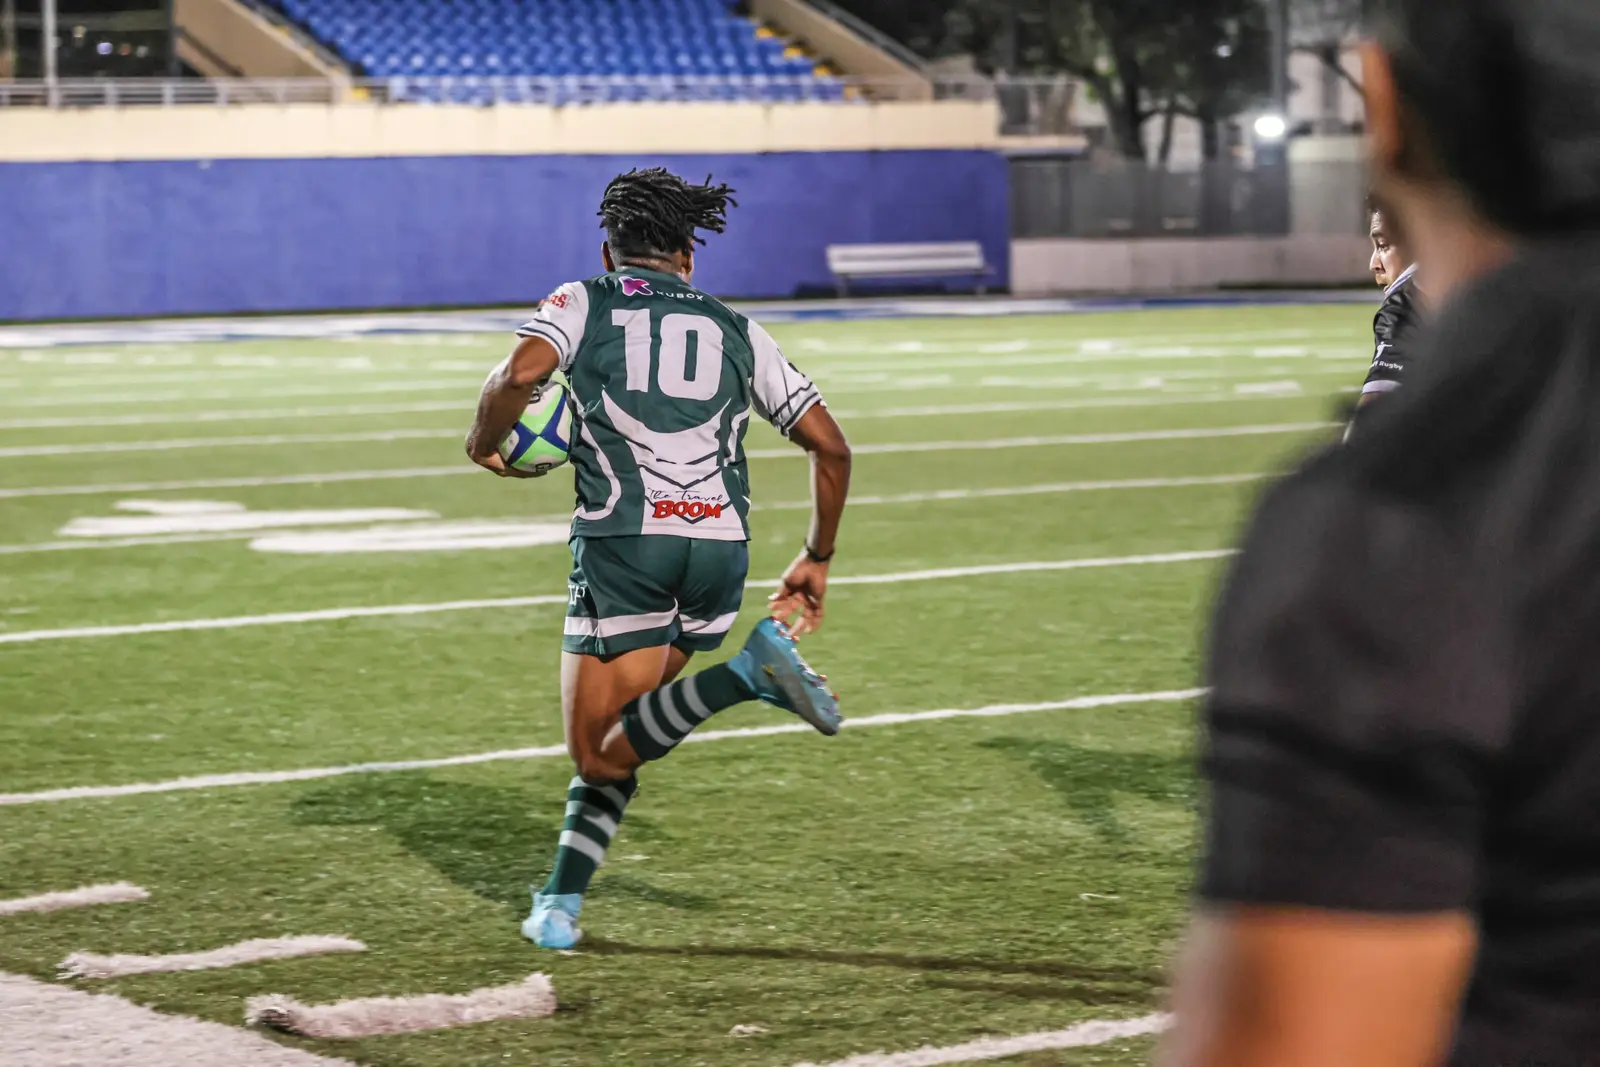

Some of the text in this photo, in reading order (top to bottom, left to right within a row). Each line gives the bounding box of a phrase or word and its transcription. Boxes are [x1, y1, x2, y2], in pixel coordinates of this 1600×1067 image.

[611, 308, 723, 401] 10
[1379, 360, 1403, 371] Rugby
[652, 500, 722, 519] BOOM
